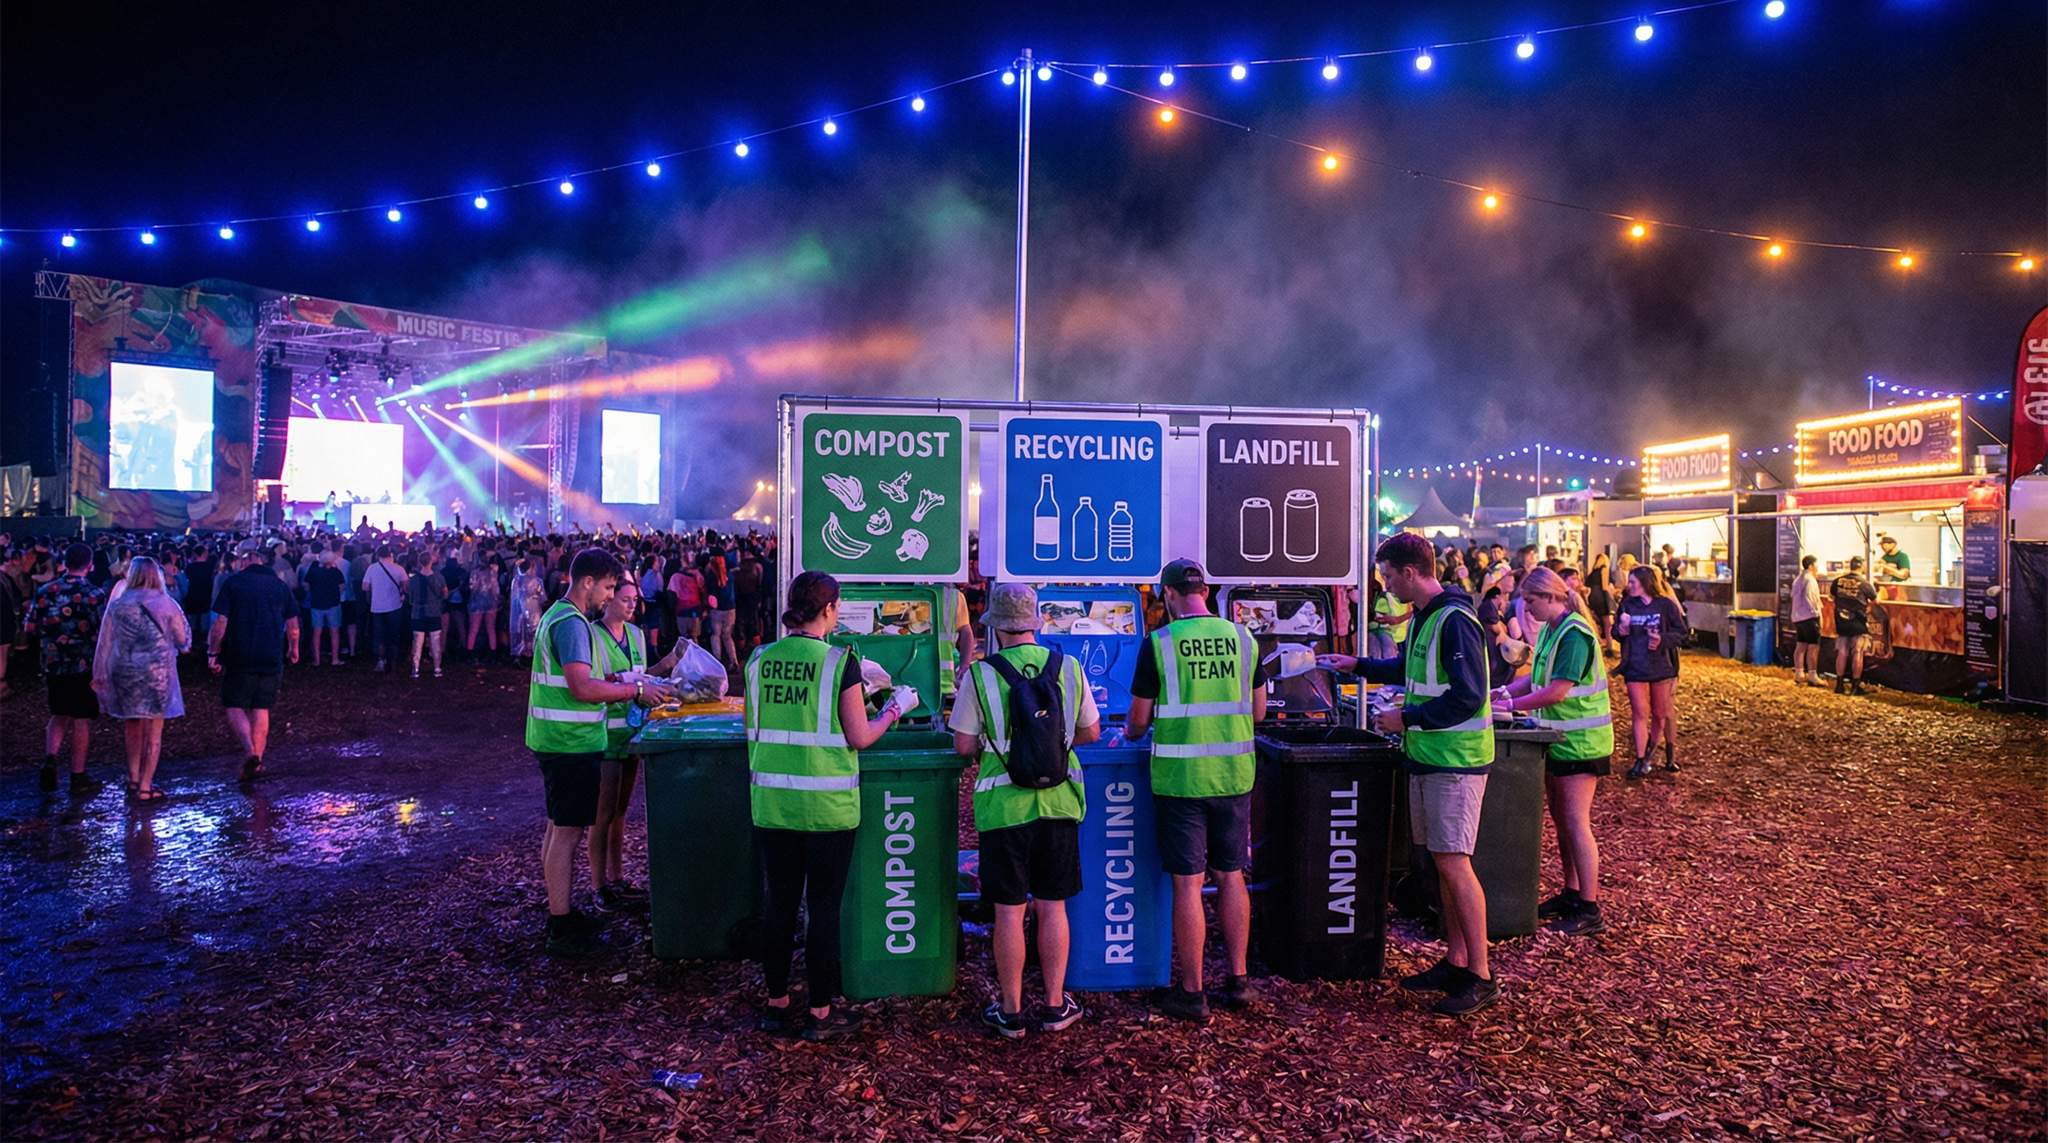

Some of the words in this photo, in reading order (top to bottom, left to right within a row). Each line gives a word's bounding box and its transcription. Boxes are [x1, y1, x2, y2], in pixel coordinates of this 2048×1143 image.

[396, 315, 456, 340] MUSIC
[814, 429, 950, 458] COMPOST
[1014, 433, 1154, 462] RECYCLING
[1829, 426, 1872, 456] FOOD
[1875, 419, 1923, 450] FOOD
[1218, 438, 1340, 467] LANDFILL
[1662, 456, 1688, 480] FOOD
[1690, 452, 1719, 476] FOOD
[1179, 637, 1238, 657] GREEN
[760, 659, 816, 682] GREEN
[1187, 659, 1236, 680] TEAM
[763, 683, 809, 706] TEAM
[1327, 780, 1359, 935] LANDFILL
[884, 790, 916, 955] COMPOST
[1104, 780, 1135, 965] RECYCLING
